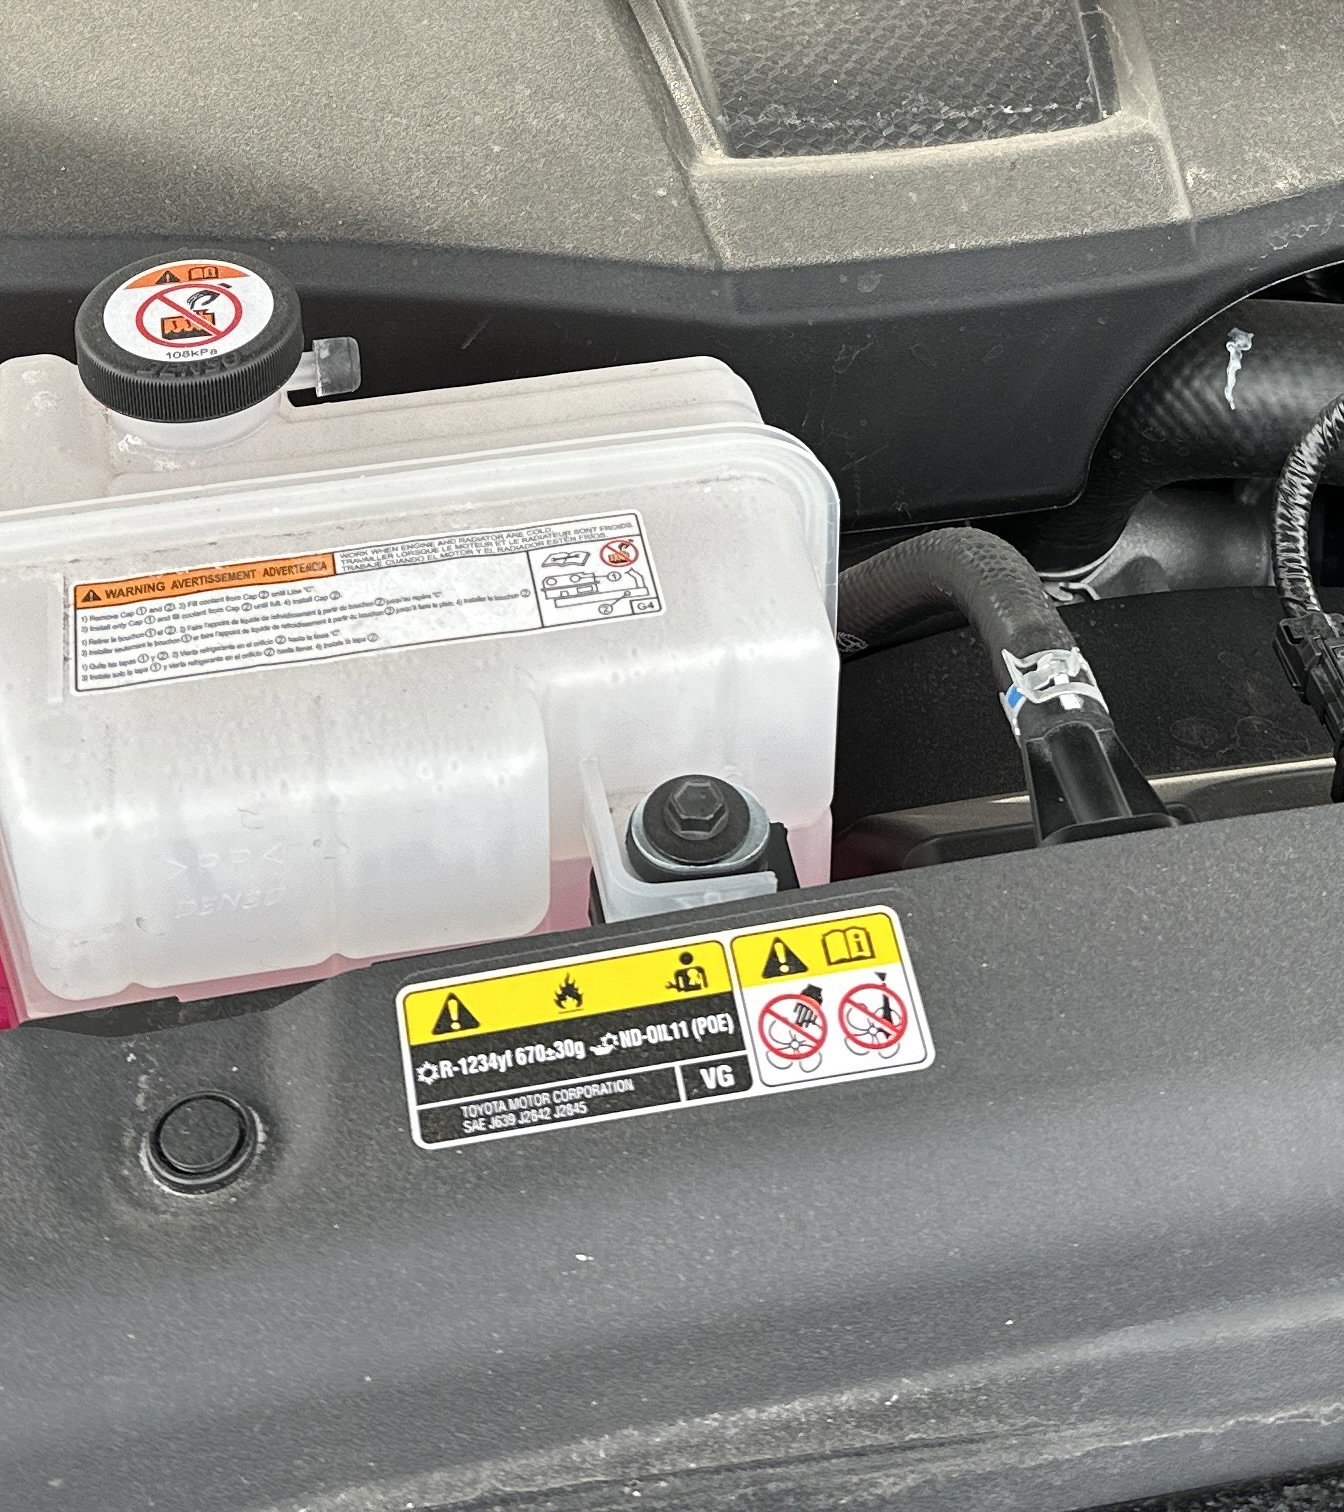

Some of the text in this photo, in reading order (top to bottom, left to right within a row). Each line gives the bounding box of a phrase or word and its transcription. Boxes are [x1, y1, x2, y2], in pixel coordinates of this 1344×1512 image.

[166, 348, 218, 360] 108kPa
[436, 538, 456, 546] AND
[104, 559, 328, 599] WARNING AVERTISSEMENT ADVERTENCIA
[439, 1012, 735, 1079] R-1234yf 670±30g ND-OIL11 (POE)
[699, 1064, 736, 1090] VG
[460, 1078, 635, 1119] TOYOTA MOTOR CORPORATION
[462, 1119, 487, 1134] SAE
[489, 1113, 516, 1130] J639
